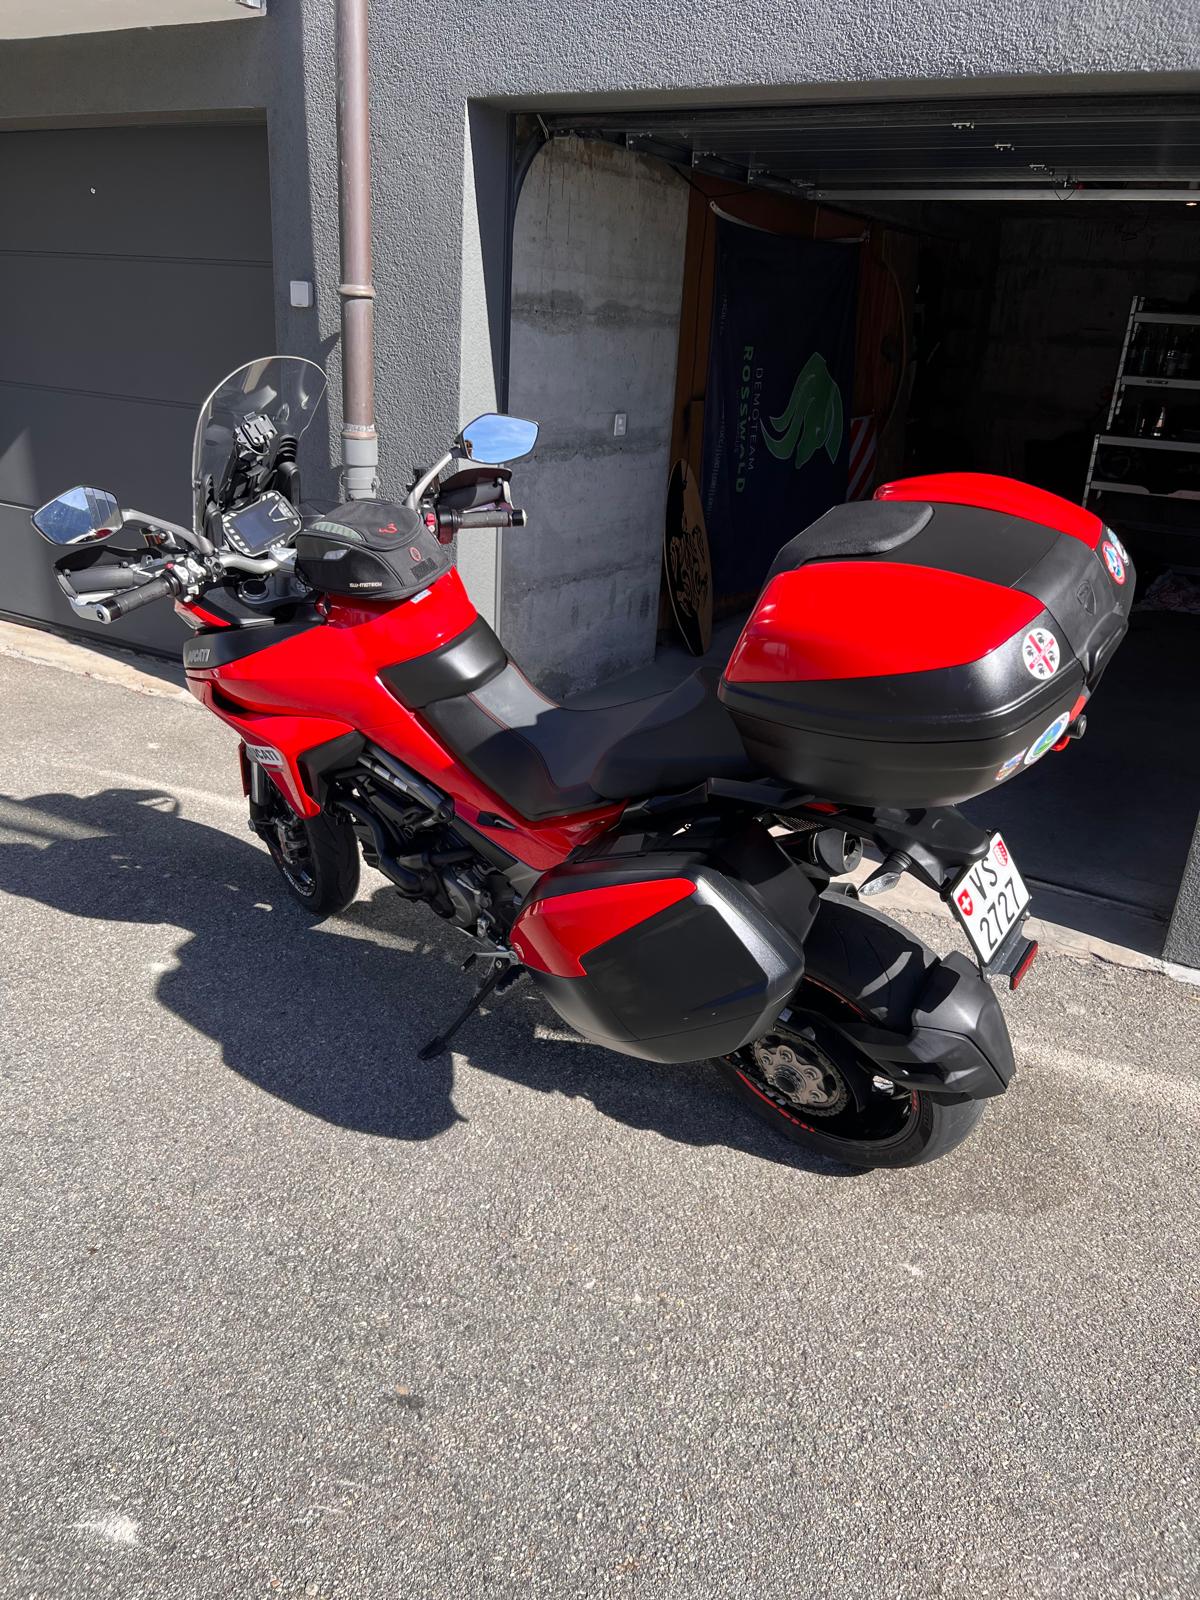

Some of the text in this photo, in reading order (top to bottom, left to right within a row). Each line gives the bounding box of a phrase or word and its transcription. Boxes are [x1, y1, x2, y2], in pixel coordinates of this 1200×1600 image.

[735, 346, 754, 493] ROSSWALD
[748, 367, 763, 471] DEMOTEAM
[969, 857, 998, 900] VS
[980, 877, 1020, 950] 2727
